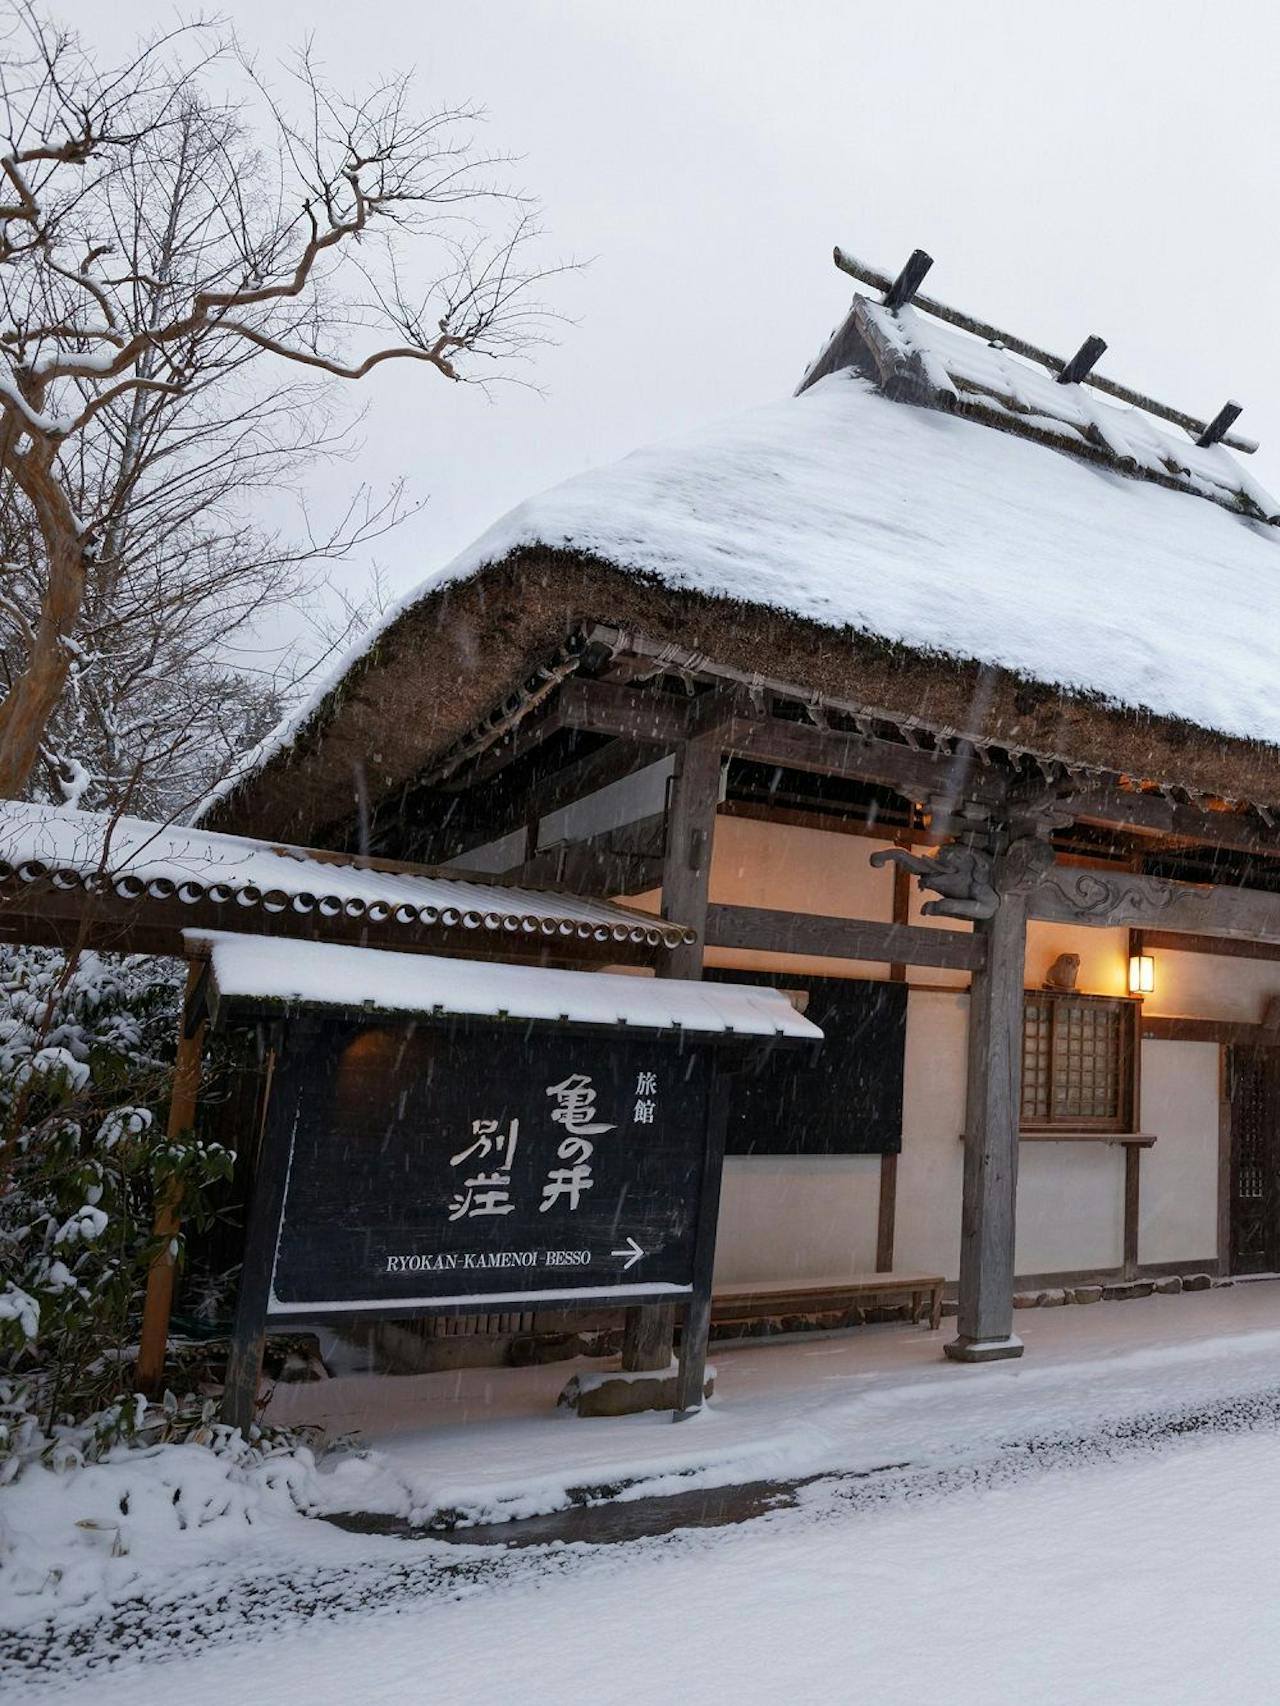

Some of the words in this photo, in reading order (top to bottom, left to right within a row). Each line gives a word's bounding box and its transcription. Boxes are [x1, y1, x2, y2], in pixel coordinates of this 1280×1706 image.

[538, 1073, 619, 1214] 亀の井
[633, 1072, 657, 1124] 旅館
[448, 1118, 519, 1222] 別荘
